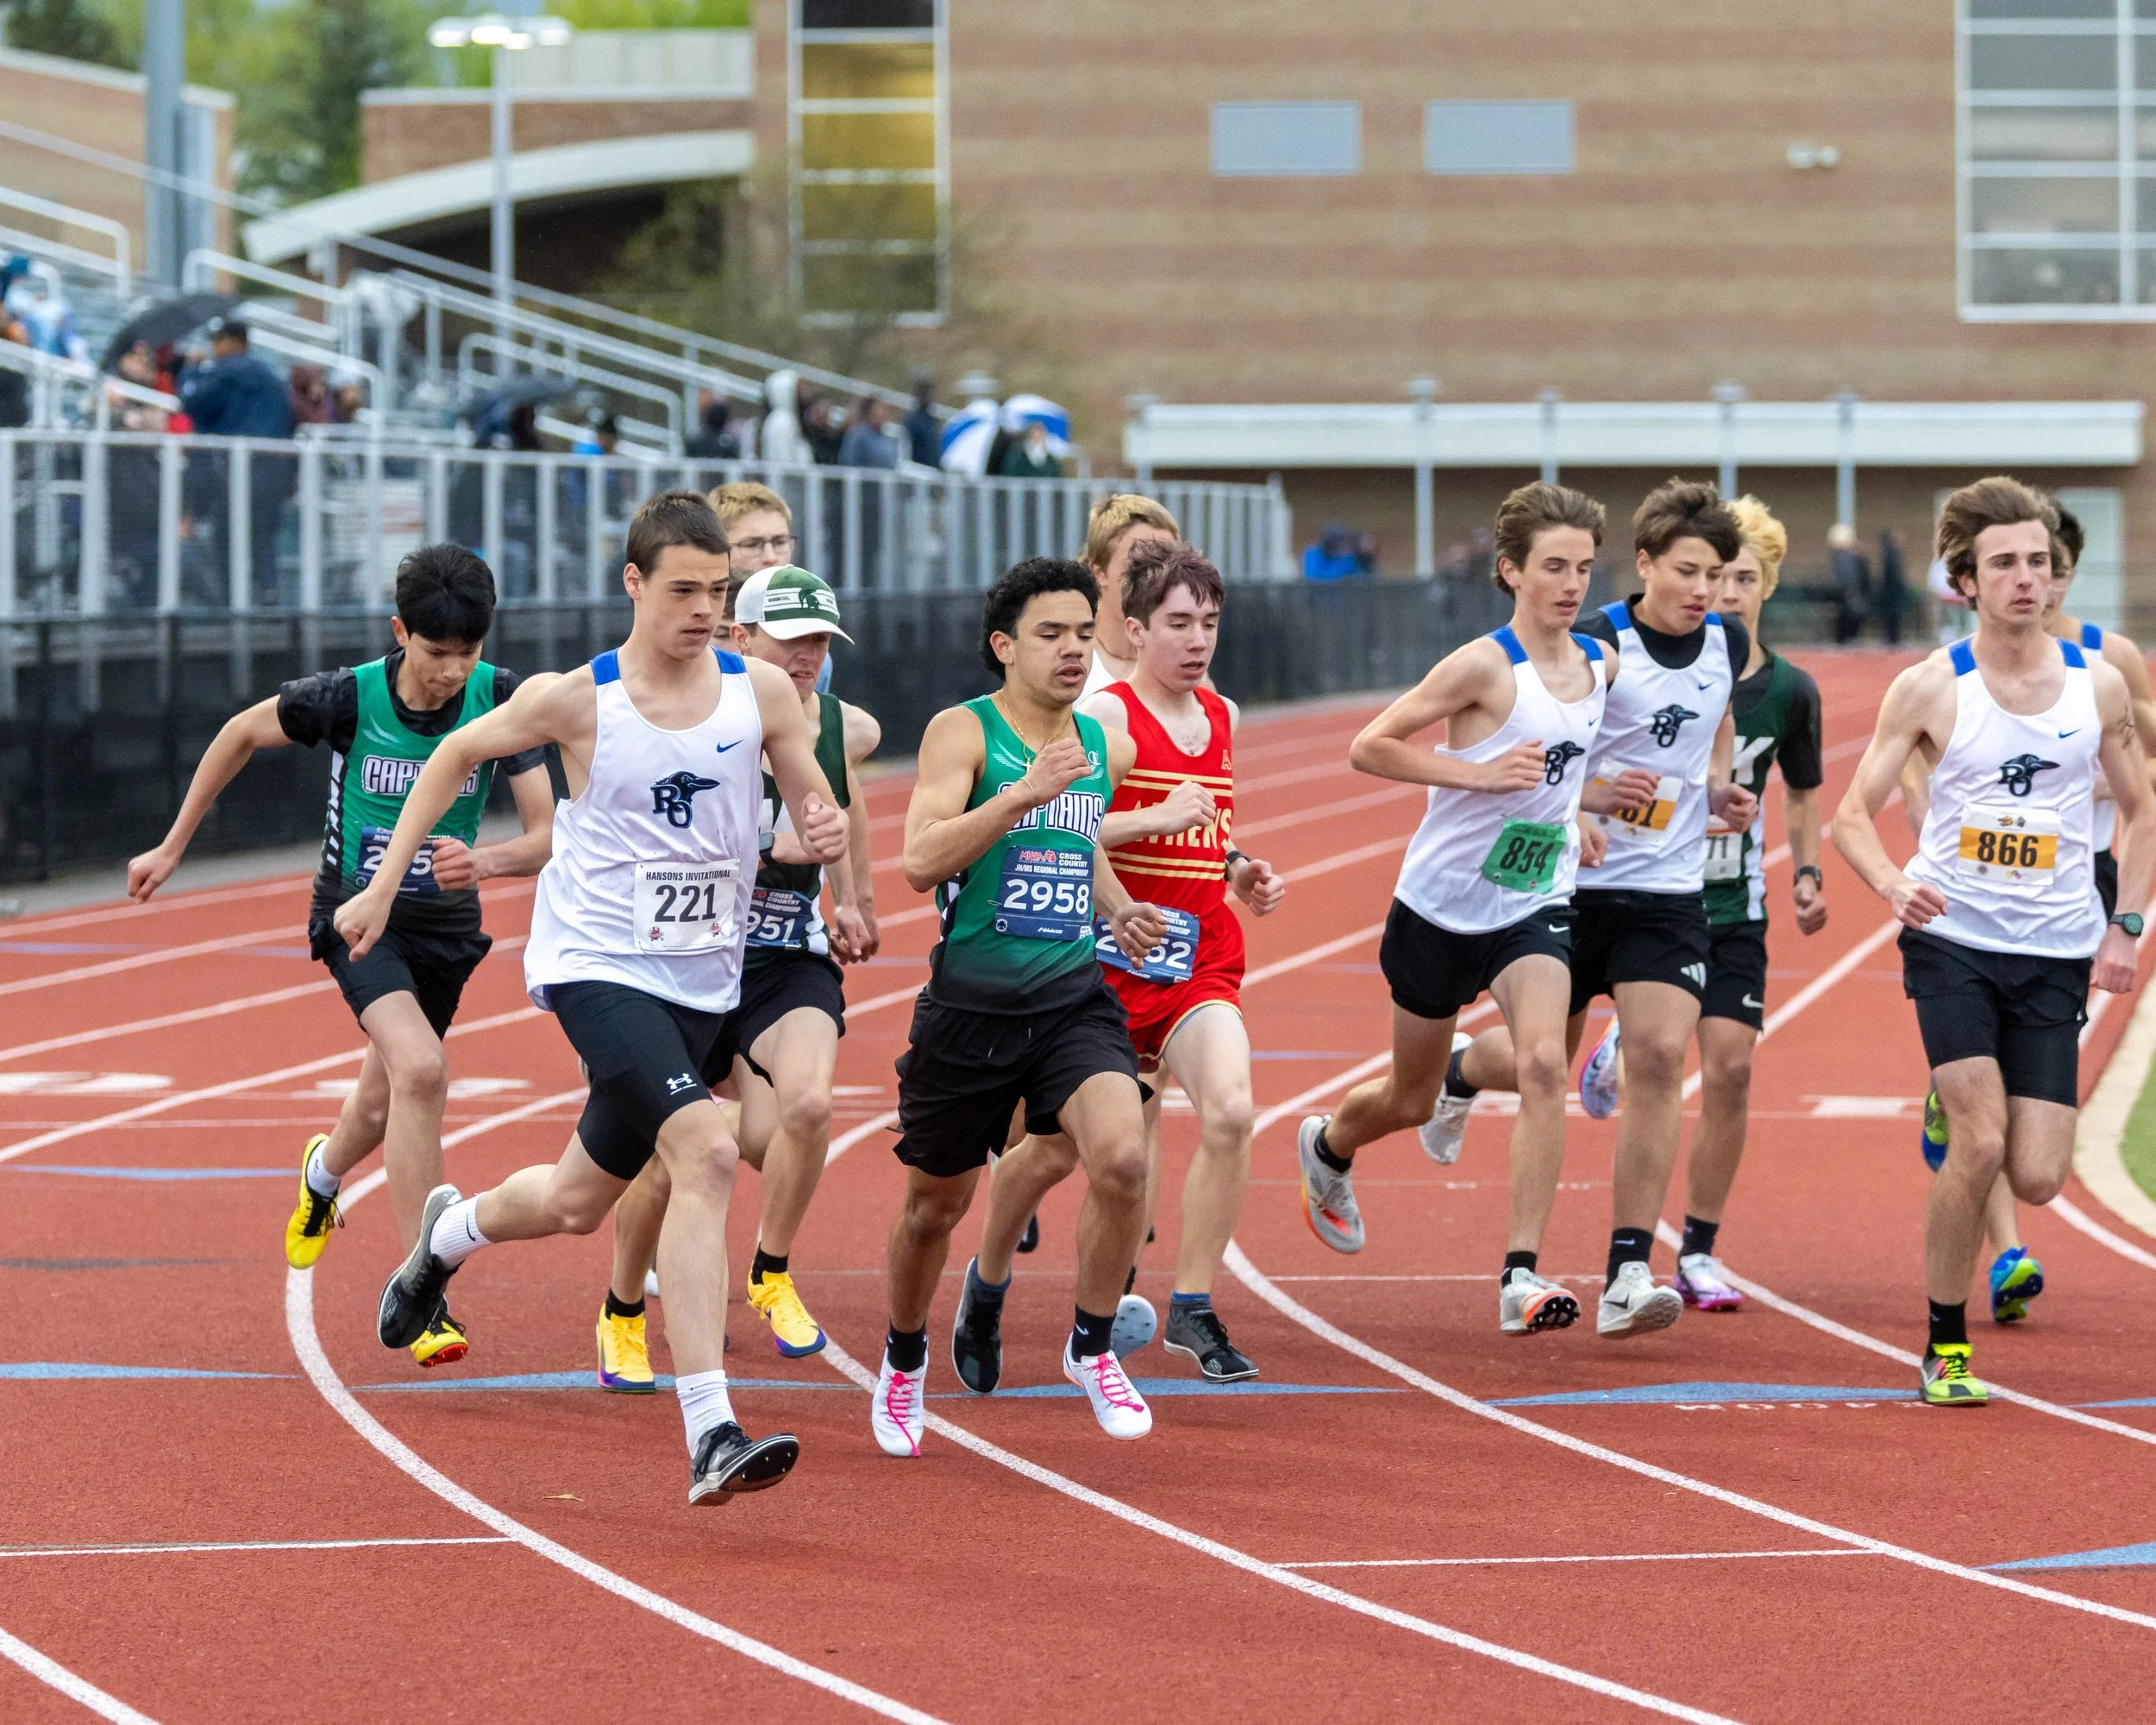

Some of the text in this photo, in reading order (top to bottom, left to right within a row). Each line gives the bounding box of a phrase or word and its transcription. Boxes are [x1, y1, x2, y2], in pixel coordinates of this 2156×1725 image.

[1221, 749, 1232, 770] A
[362, 755, 480, 796] CAPS
[998, 782, 1105, 846] TAINS
[1058, 859, 1088, 868] COUNTRY
[1059, 852, 1082, 861] CROSS
[1500, 836, 1555, 876] 854
[1977, 831, 2039, 868] 866
[646, 869, 730, 881] HANSONS INVITATIONAL
[1033, 865, 1058, 875] REGIONAL
[655, 883, 717, 923] 221
[767, 896, 800, 906] COUNTRY
[1003, 878, 1090, 915] 2958
